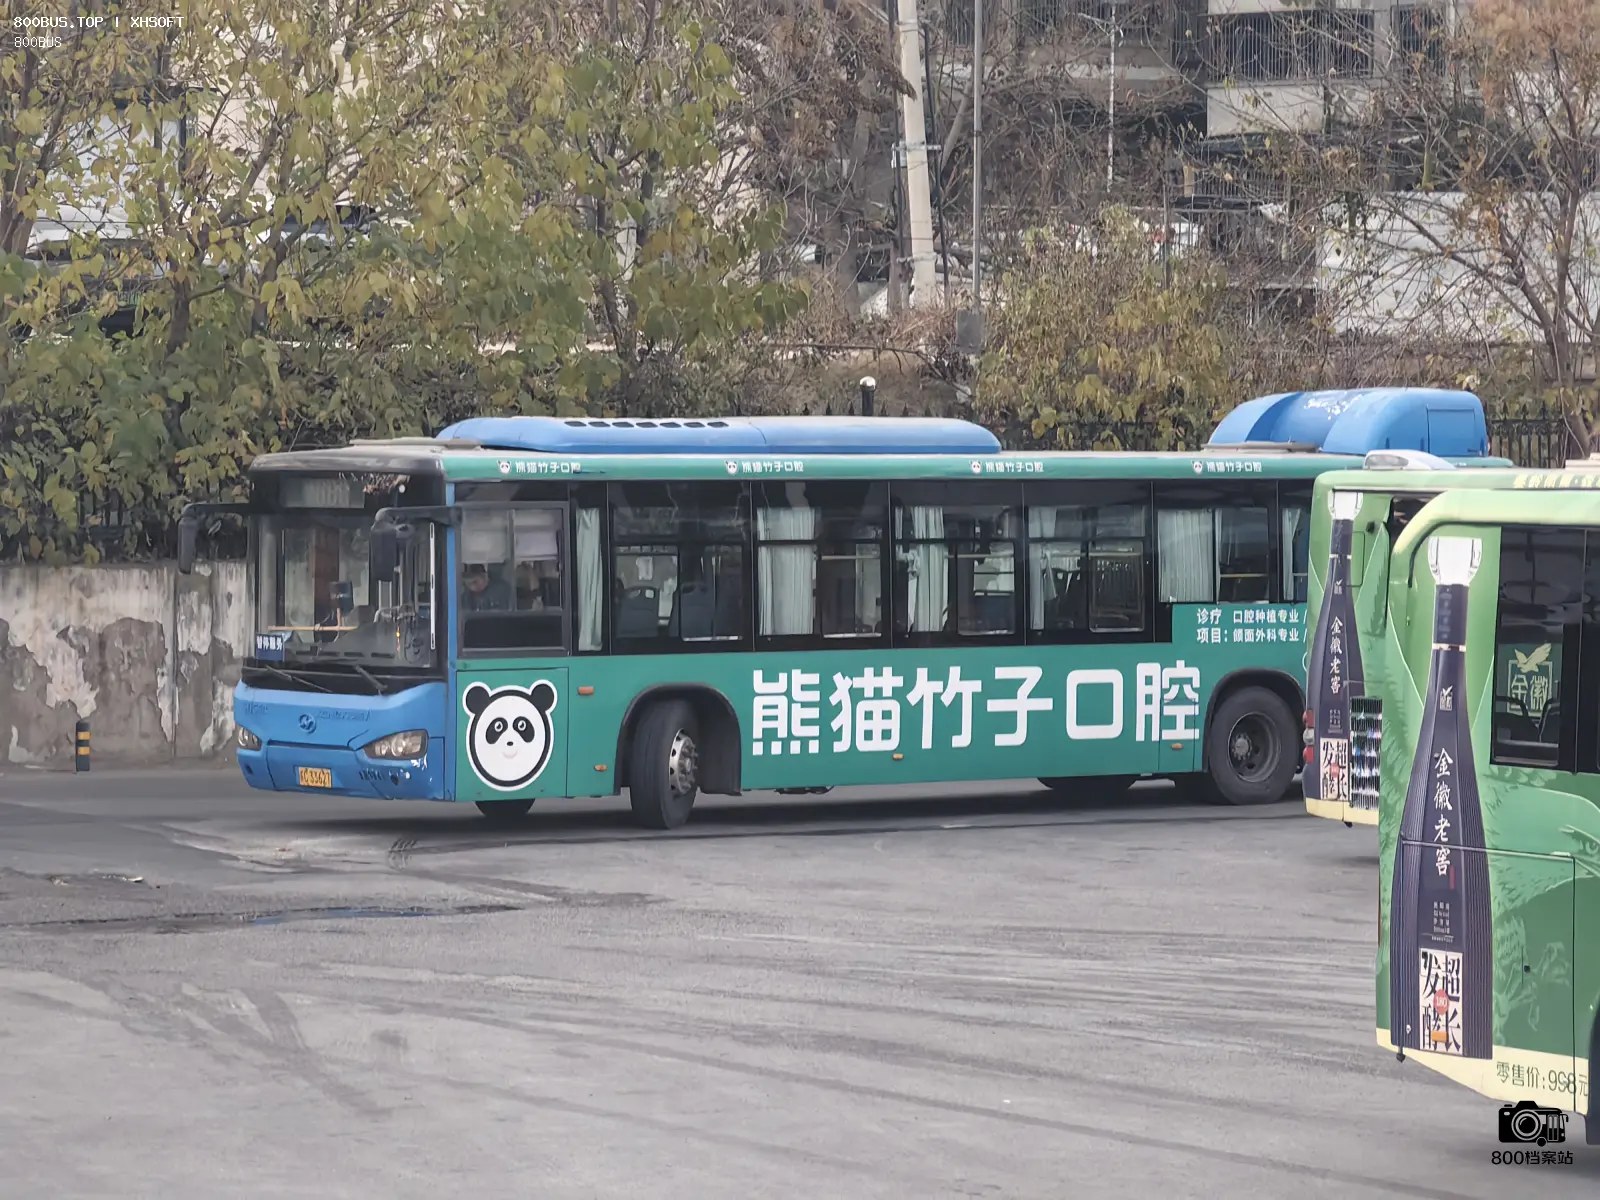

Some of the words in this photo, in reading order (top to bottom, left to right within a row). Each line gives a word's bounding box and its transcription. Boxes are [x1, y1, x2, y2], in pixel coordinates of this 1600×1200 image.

[1196, 607, 1222, 624] 诊疗
[1233, 608, 1299, 624] 口腔种植专业
[1233, 628, 1299, 643] 颌面外科专业
[1329, 616, 1344, 694] 金徽老窖
[752, 660, 1200, 756] 熊猫竹子口腔
[1433, 748, 1454, 876] 金徽老窖
